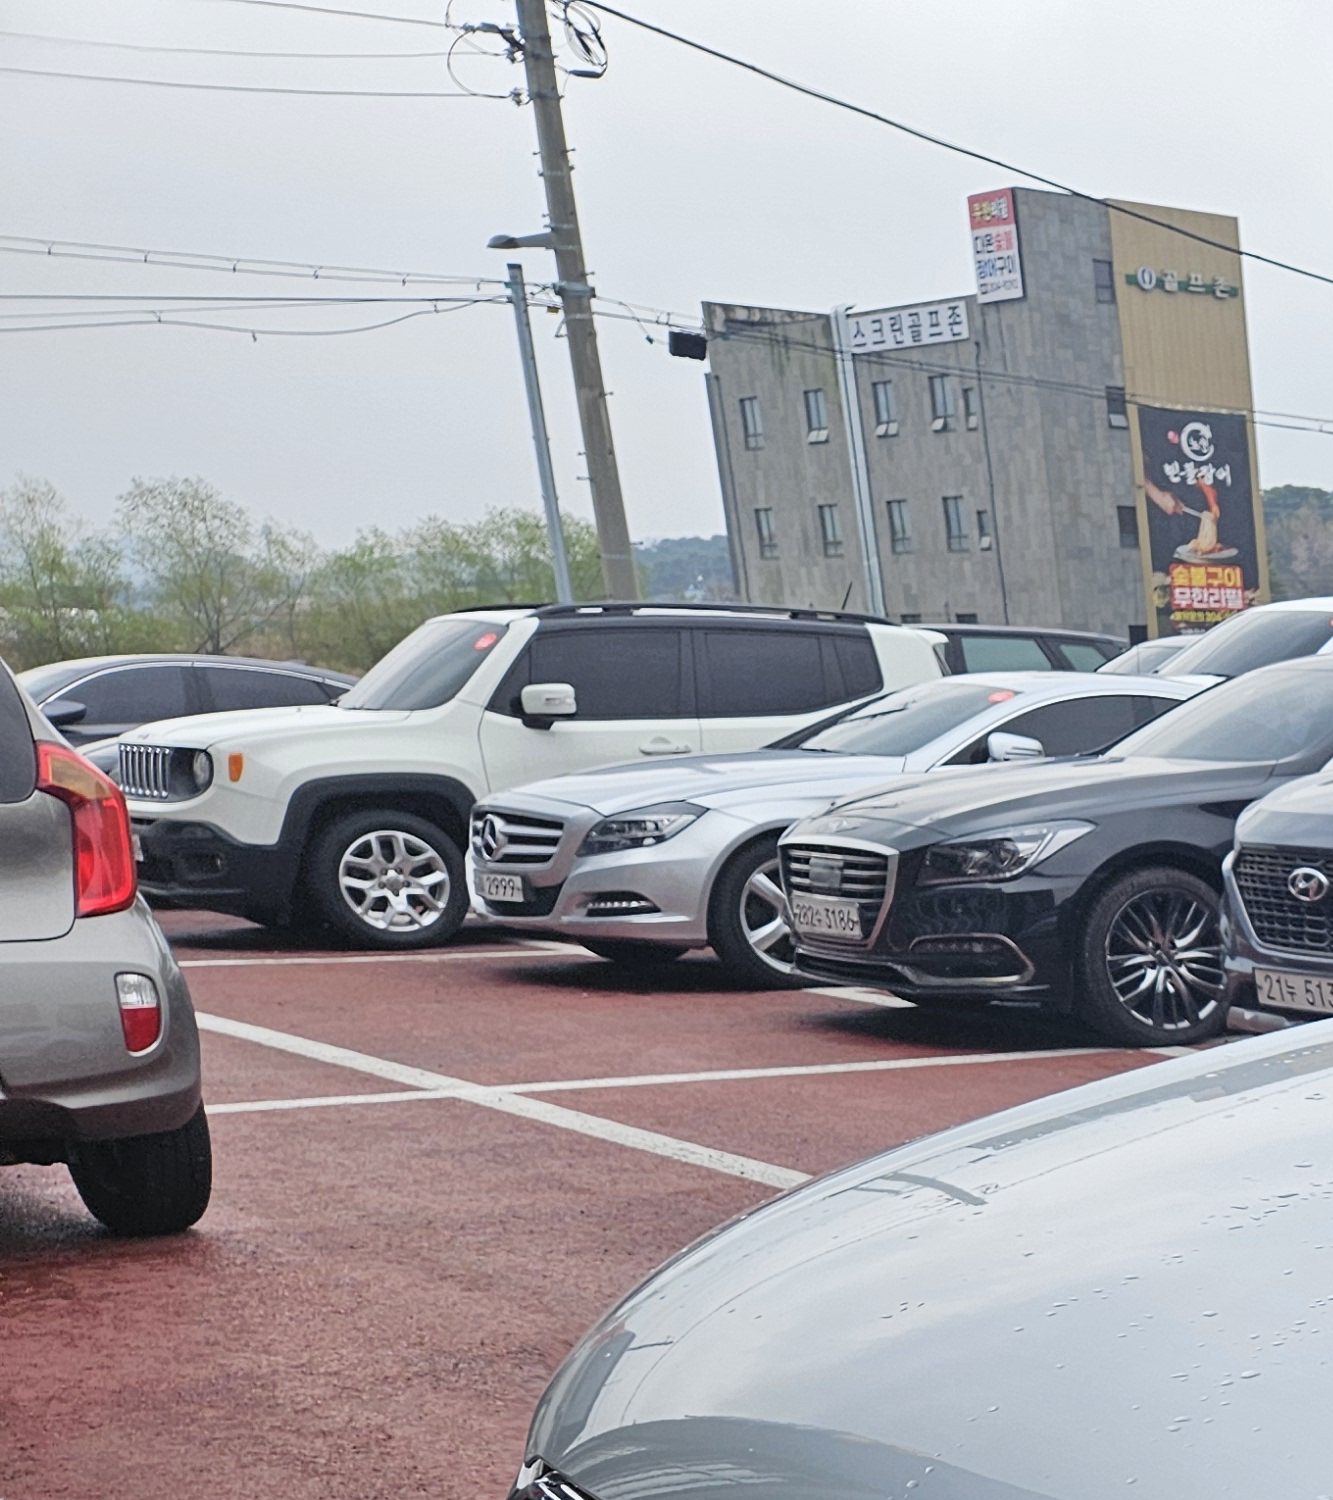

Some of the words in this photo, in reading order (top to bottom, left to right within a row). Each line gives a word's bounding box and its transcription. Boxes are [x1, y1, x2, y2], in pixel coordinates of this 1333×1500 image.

[1161, 269, 1232, 299] 골프존
[853, 305, 963, 348] 스크린골프존
[1172, 565, 1242, 587] 숯불구이
[1174, 587, 1244, 609] 무한리필
[486, 876, 515, 897] 2999
[824, 907, 855, 932] 3186
[1264, 974, 1297, 1003] 21누
